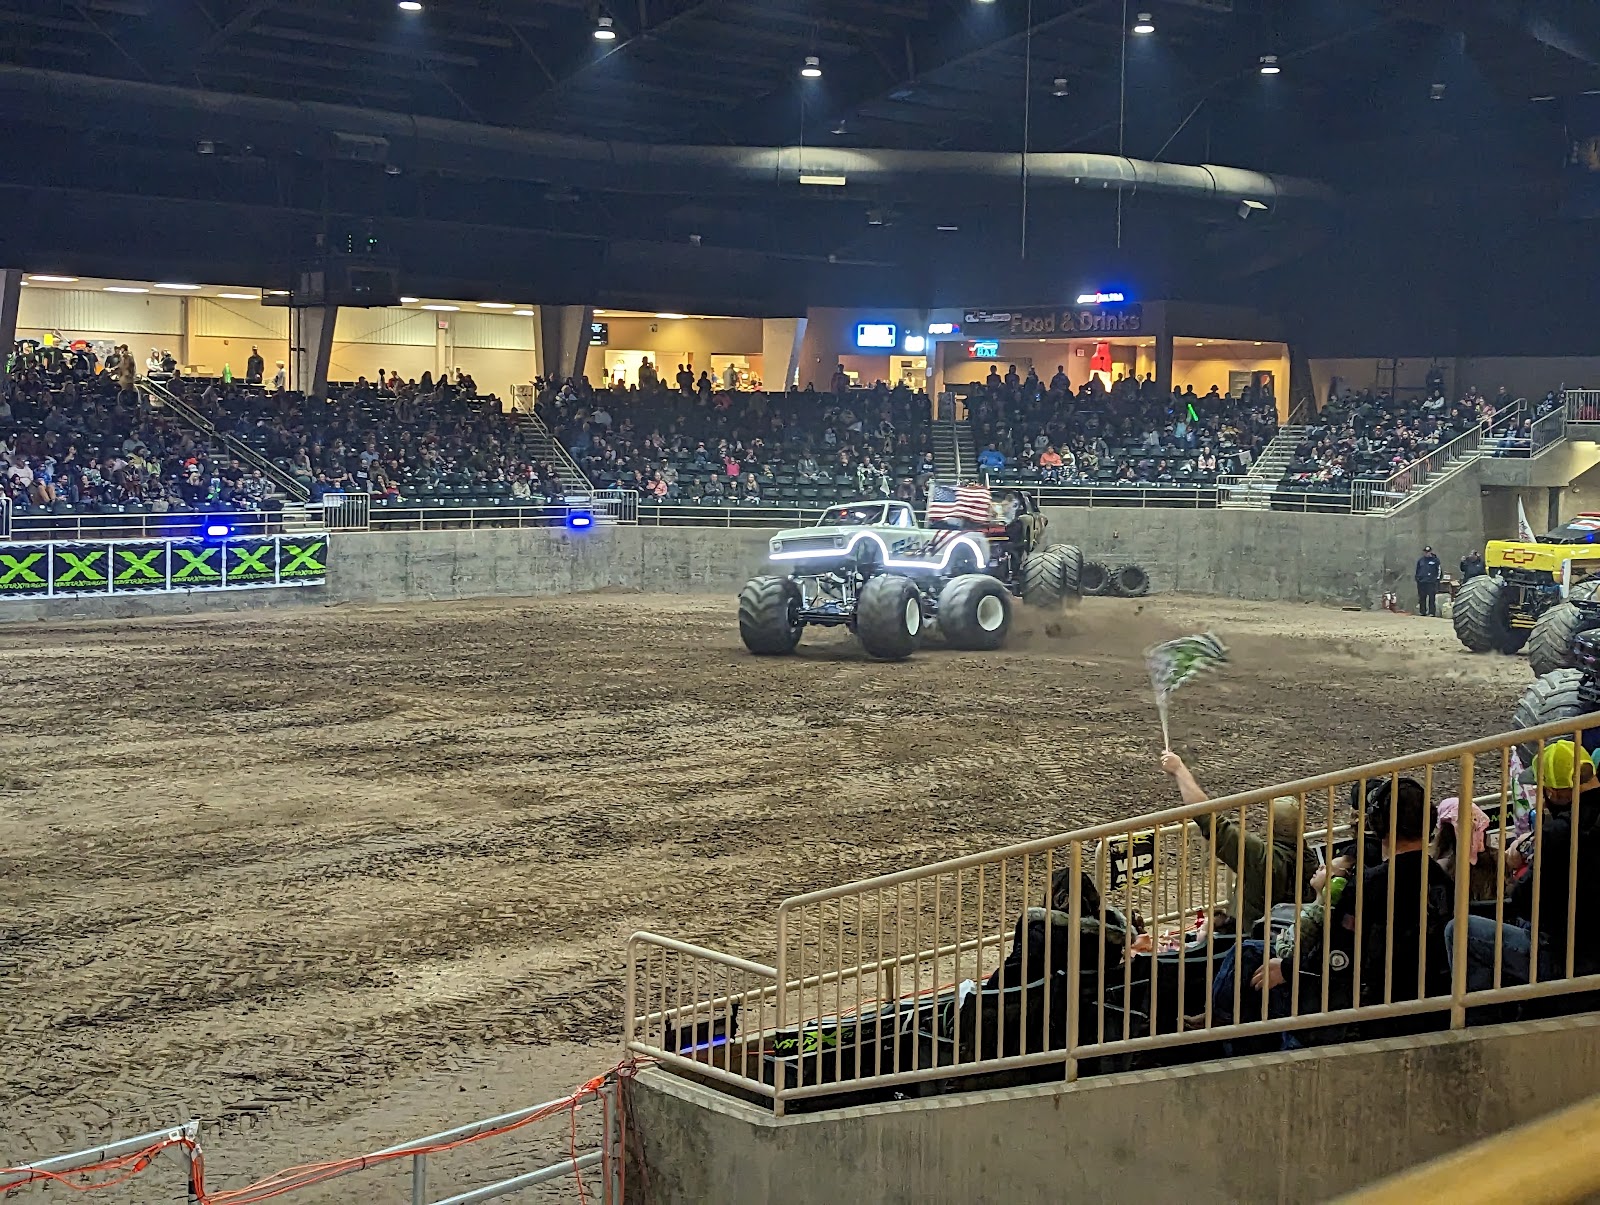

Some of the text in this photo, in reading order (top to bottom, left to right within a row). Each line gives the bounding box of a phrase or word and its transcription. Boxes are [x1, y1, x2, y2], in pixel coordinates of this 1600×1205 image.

[1010, 312, 1055, 333] Food
[1060, 311, 1076, 332] &
[1079, 310, 1141, 331] Drinks
[977, 347, 996, 357] BAR
[1115, 853, 1152, 872] VIP
[1116, 869, 1152, 884] Aea
